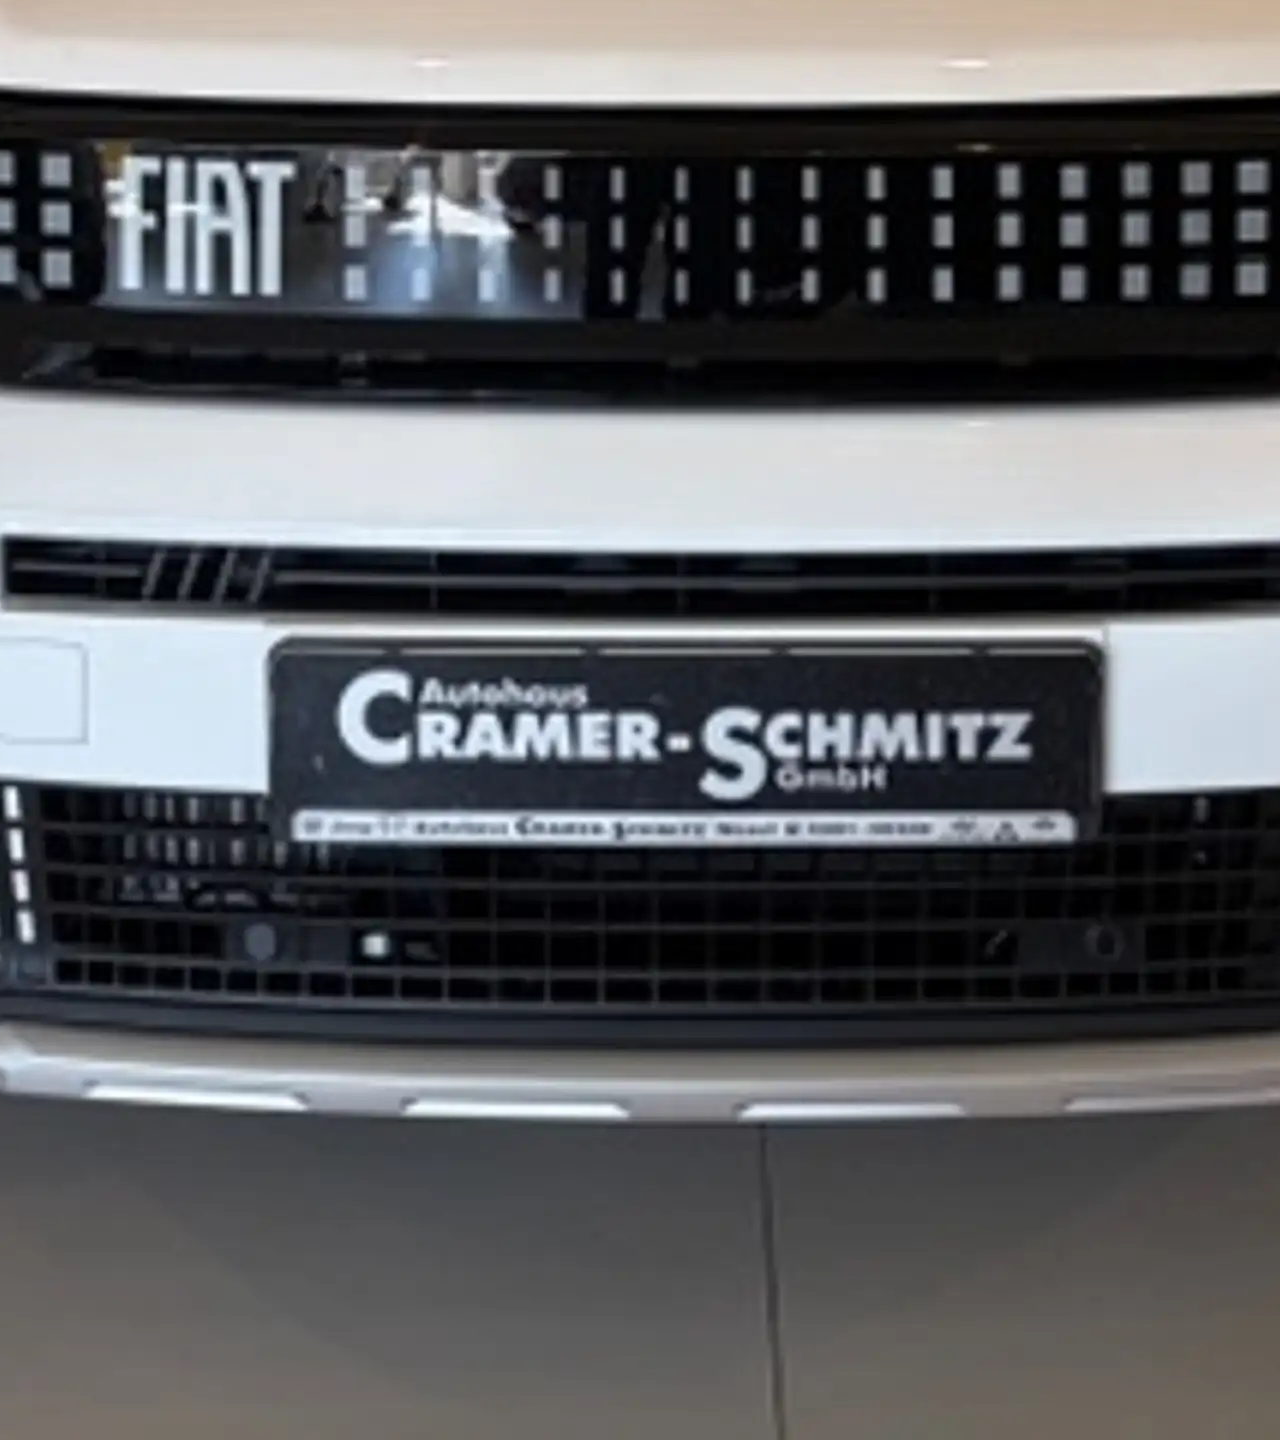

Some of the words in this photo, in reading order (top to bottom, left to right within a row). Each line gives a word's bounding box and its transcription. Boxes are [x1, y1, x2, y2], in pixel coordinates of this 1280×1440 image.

[119, 156, 296, 297] FIAT
[420, 676, 589, 709] Autohaus
[337, 669, 1033, 800] CRAMER-SCHMITZ
[775, 762, 888, 791] GmbH
